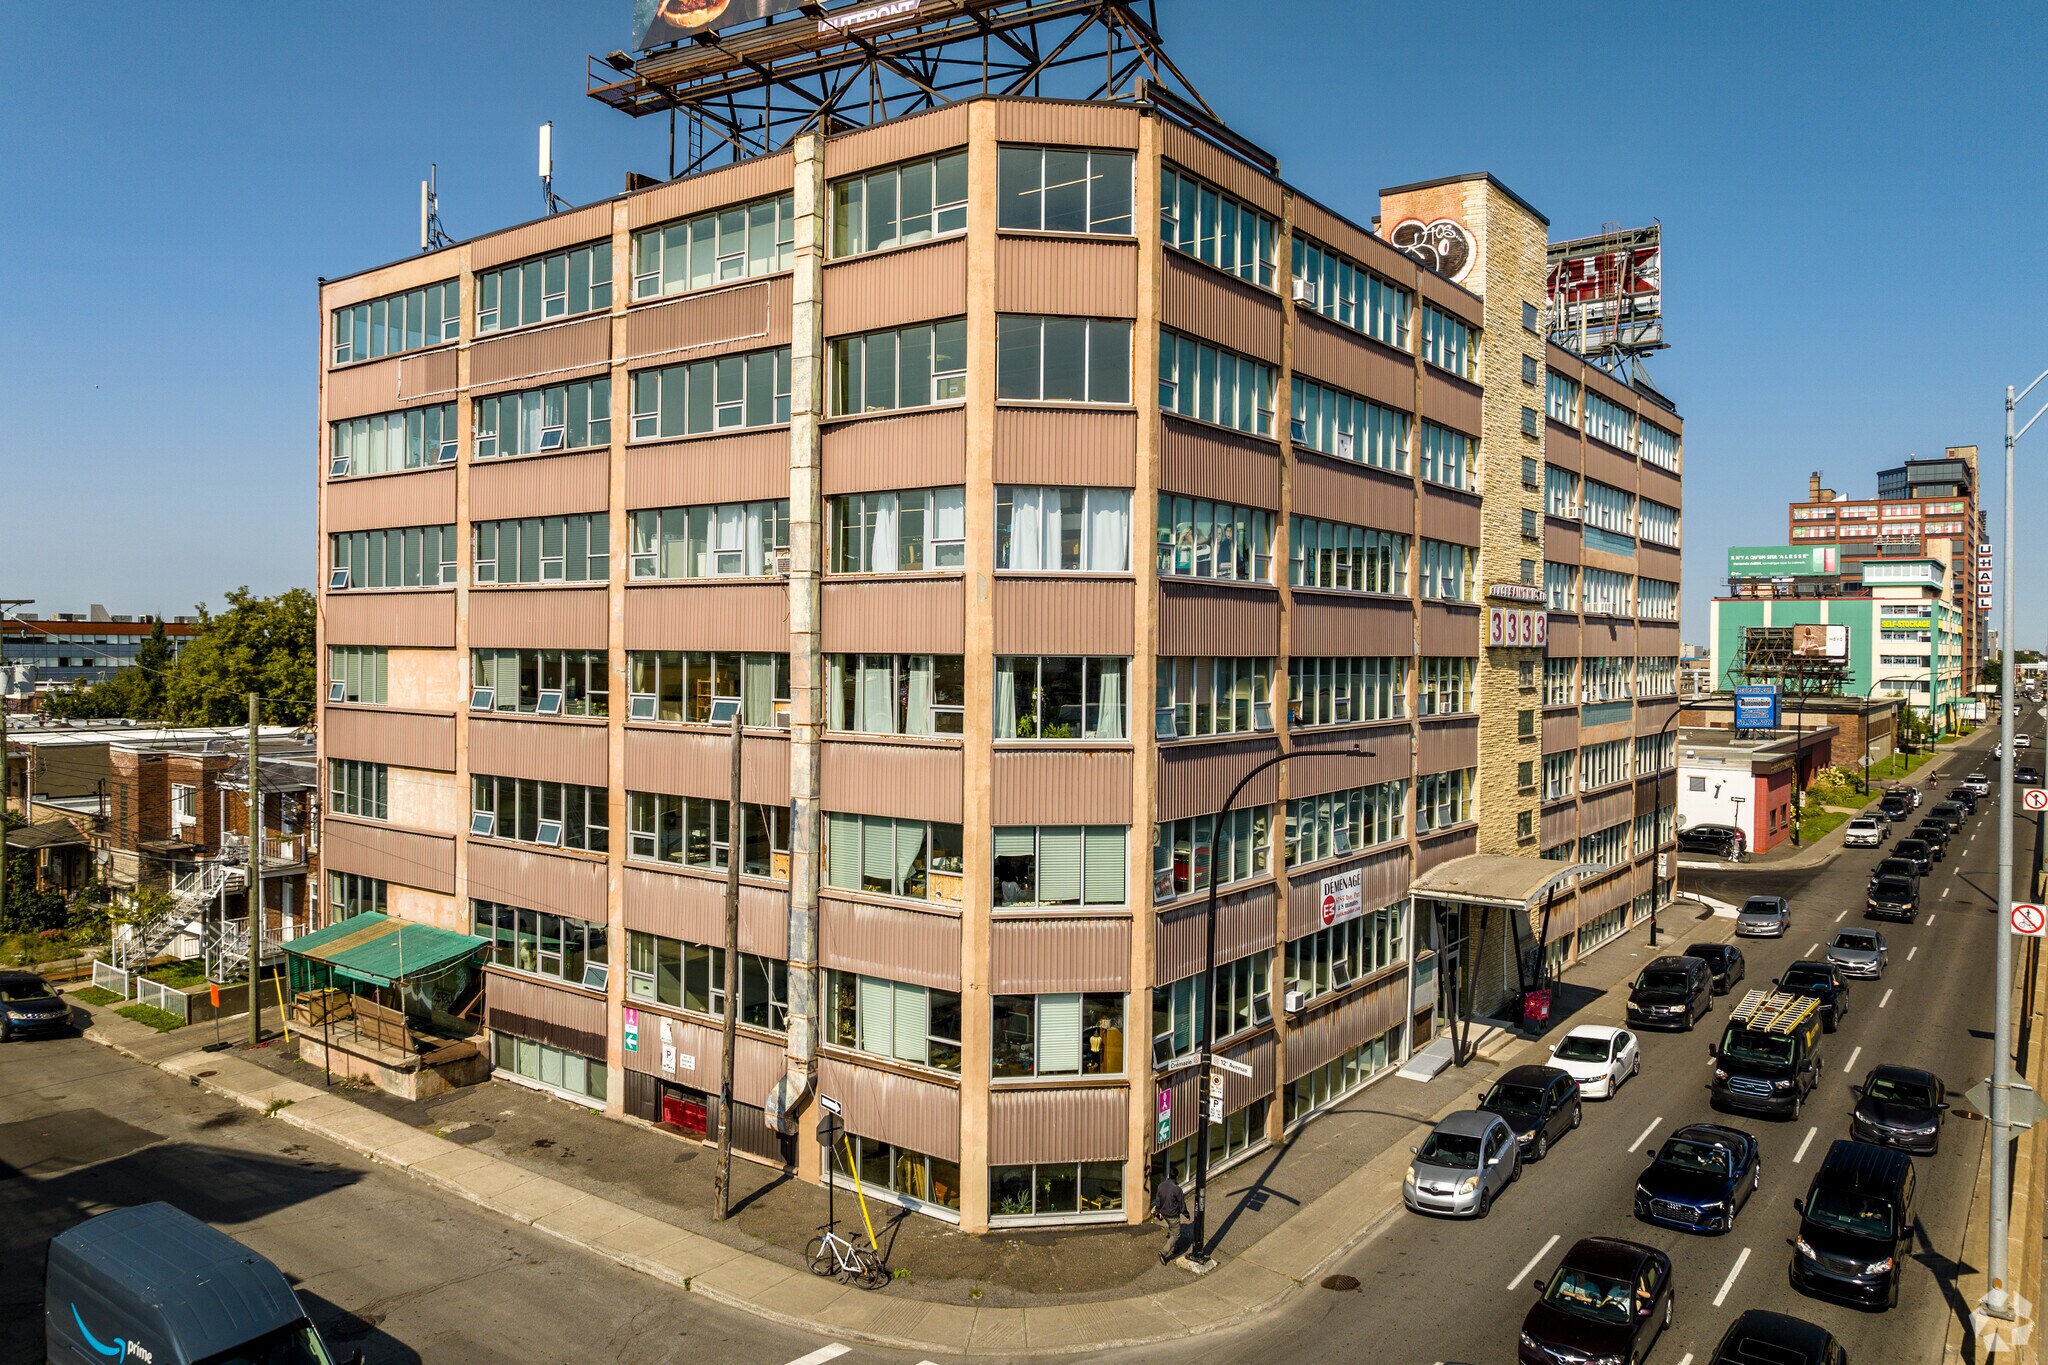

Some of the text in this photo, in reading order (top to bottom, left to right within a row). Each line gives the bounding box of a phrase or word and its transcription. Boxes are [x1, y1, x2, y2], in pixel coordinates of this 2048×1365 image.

[1881, 620, 1930, 628] SELF-STOCKAGE
[1170, 1060, 1192, 1069] Crémazie
[1229, 1062, 1248, 1073] Avenue
[1213, 1099, 1219, 1108] P
[127, 1340, 153, 1364] prime
